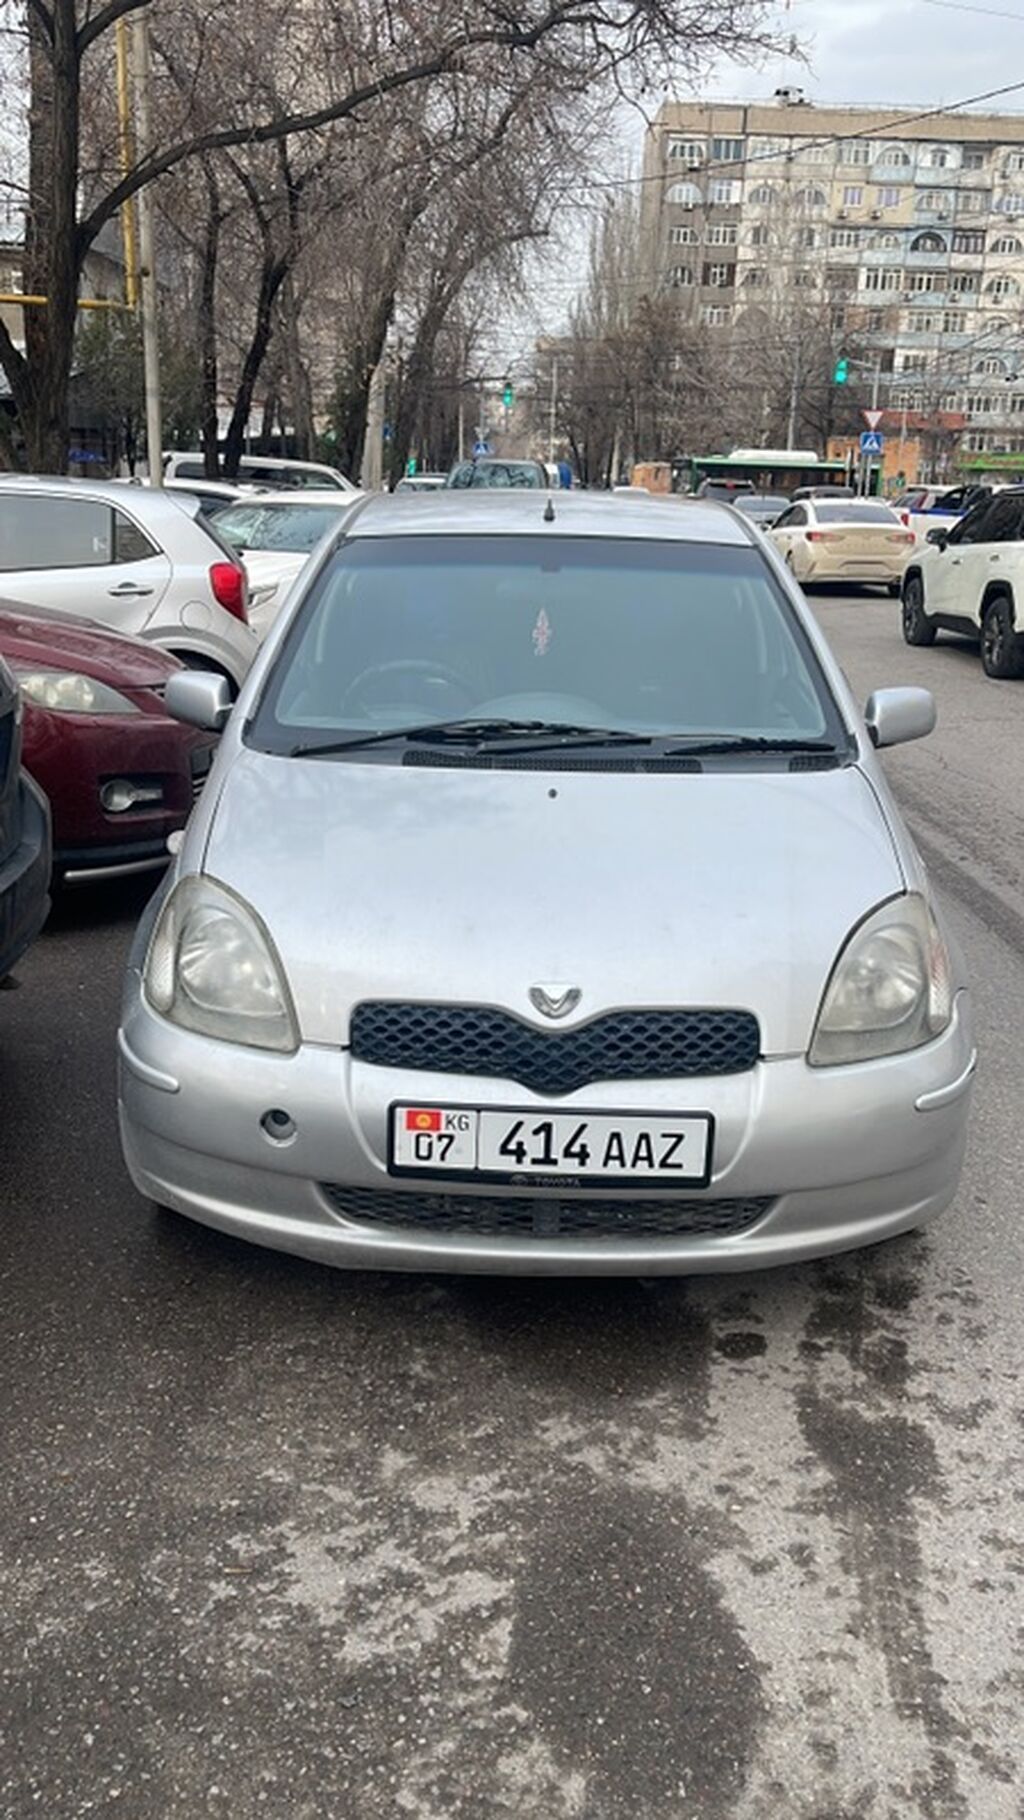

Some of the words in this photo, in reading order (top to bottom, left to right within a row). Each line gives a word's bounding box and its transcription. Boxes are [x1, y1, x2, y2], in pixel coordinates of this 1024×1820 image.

[445, 1114, 470, 1131] KG
[414, 1133, 455, 1161] 07
[499, 1120, 590, 1167] 414
[602, 1131, 685, 1169] AAZ
[534, 1177, 581, 1187] TOYOTA
